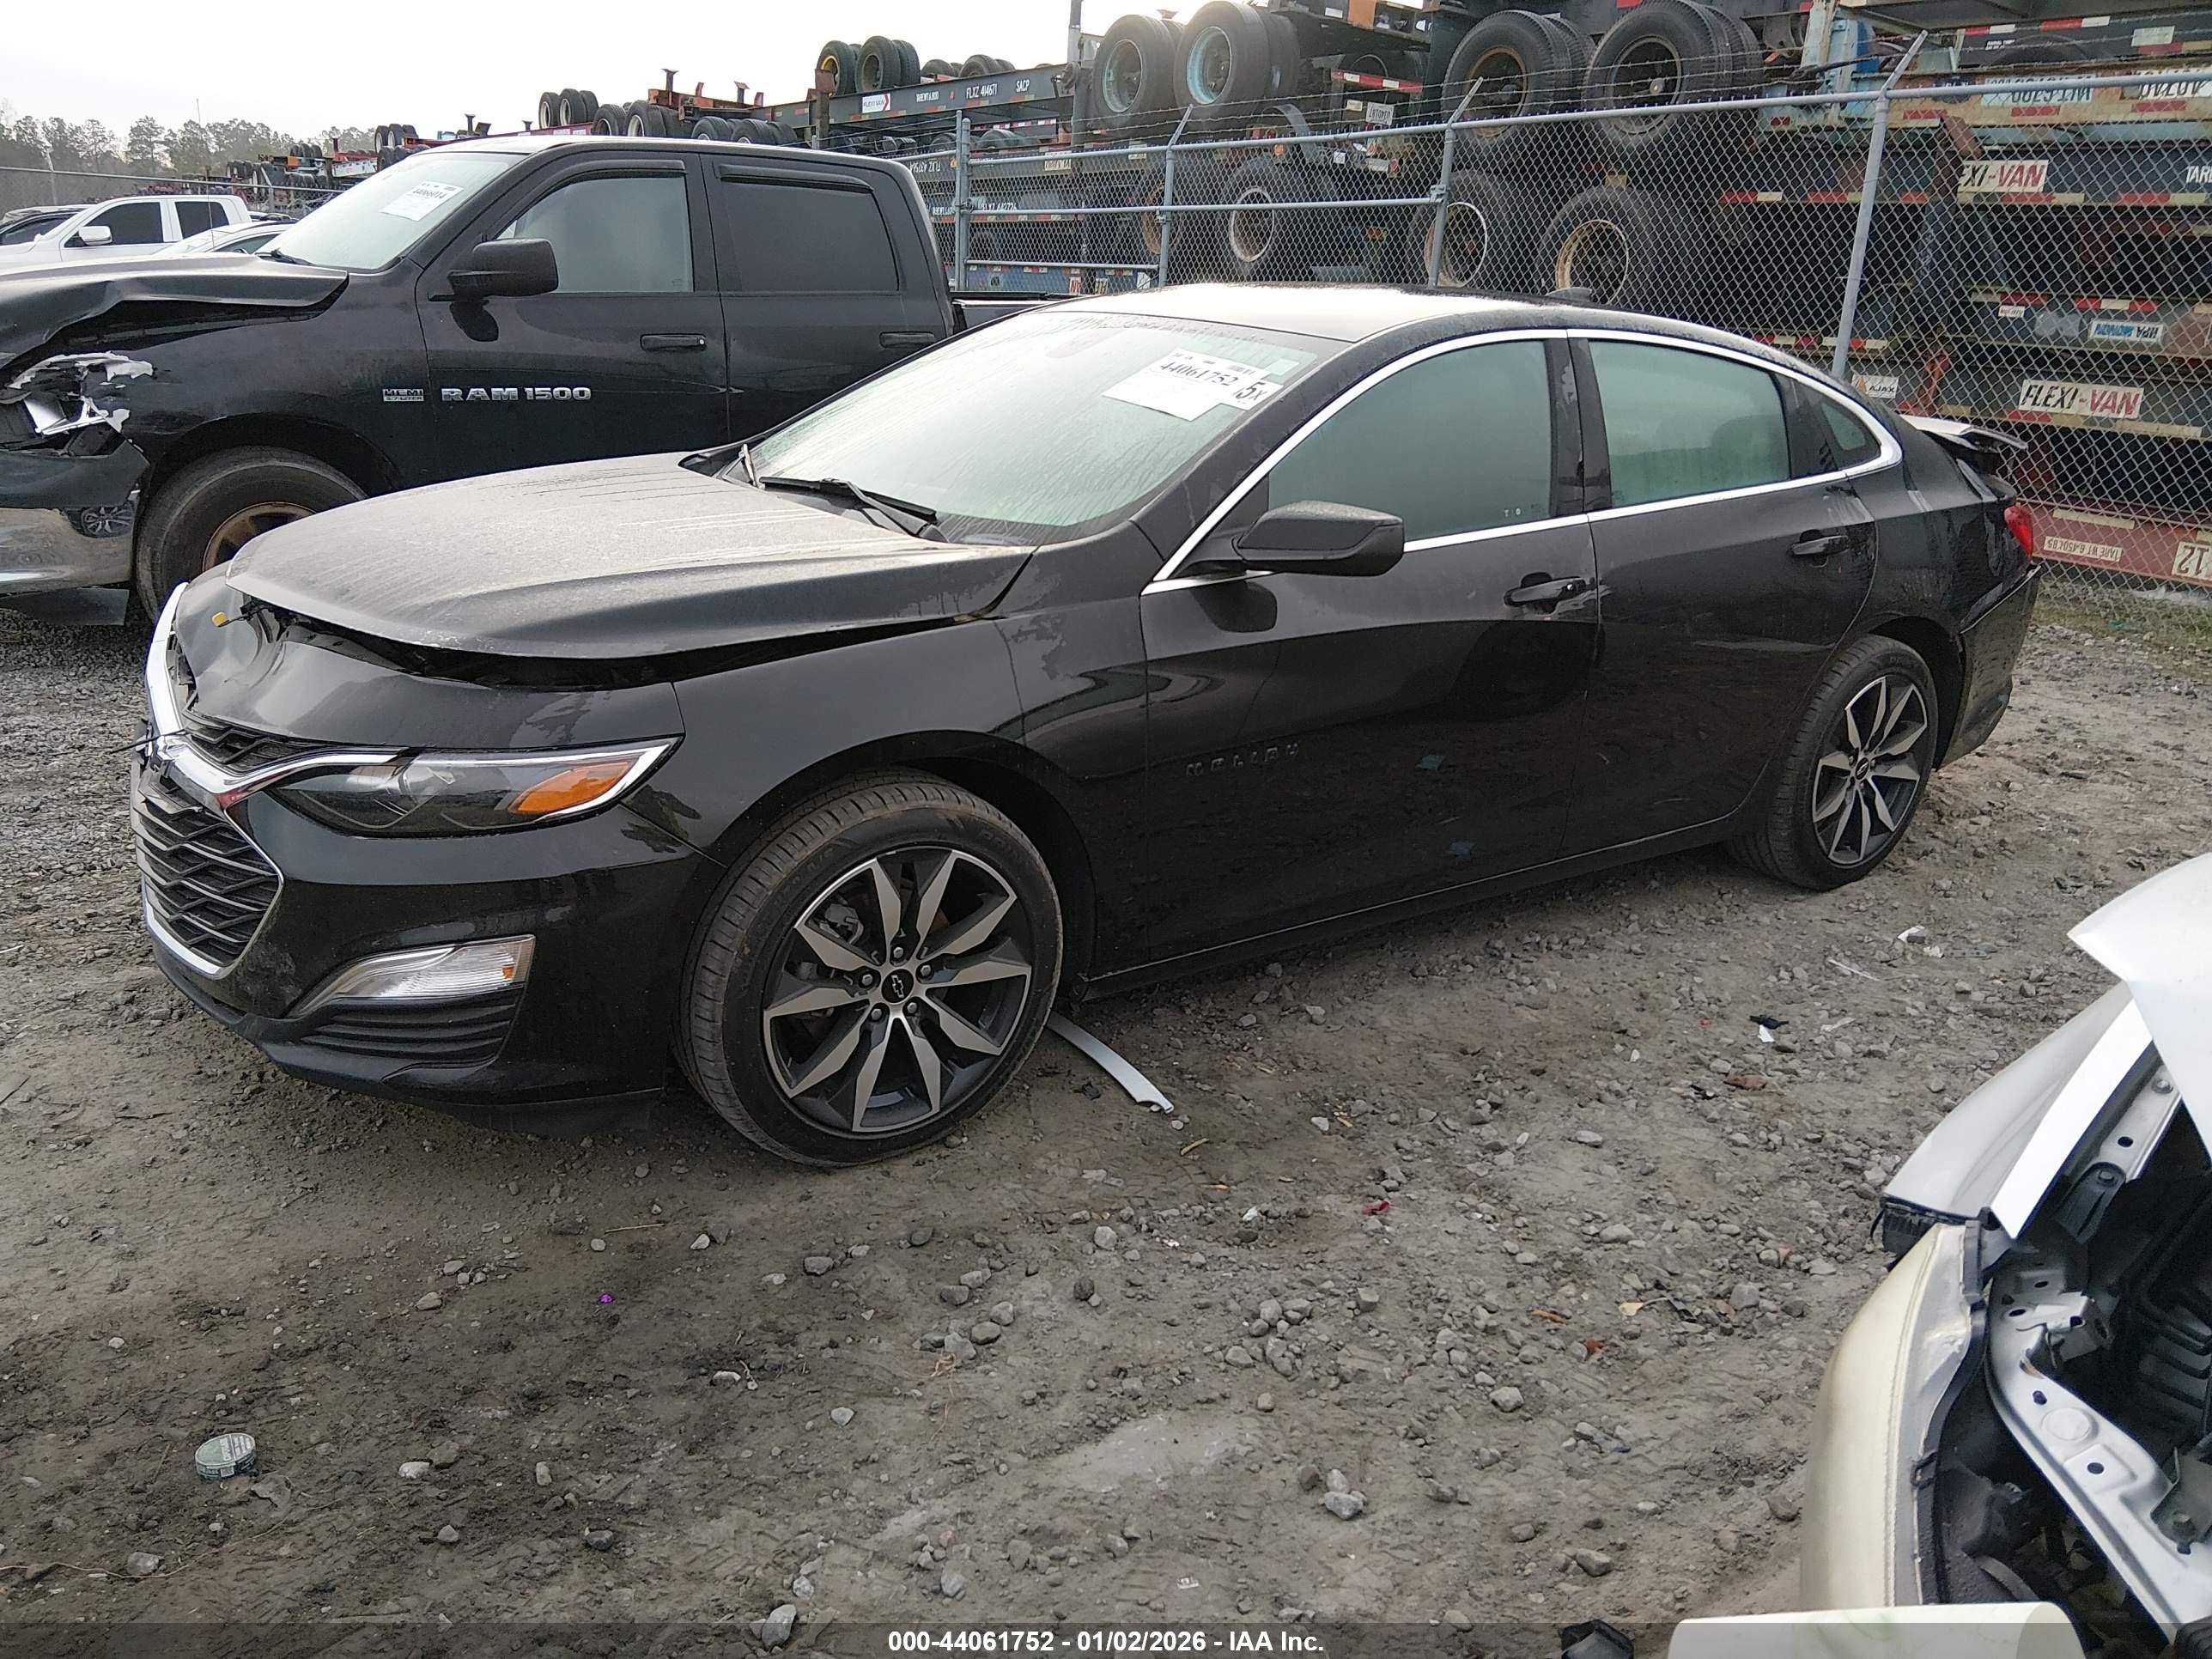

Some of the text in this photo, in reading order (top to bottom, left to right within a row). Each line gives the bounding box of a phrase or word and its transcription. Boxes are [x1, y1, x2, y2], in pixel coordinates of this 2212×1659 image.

[1160, 361, 1239, 386] 44061752
[441, 386, 592, 401] RAM 1500
